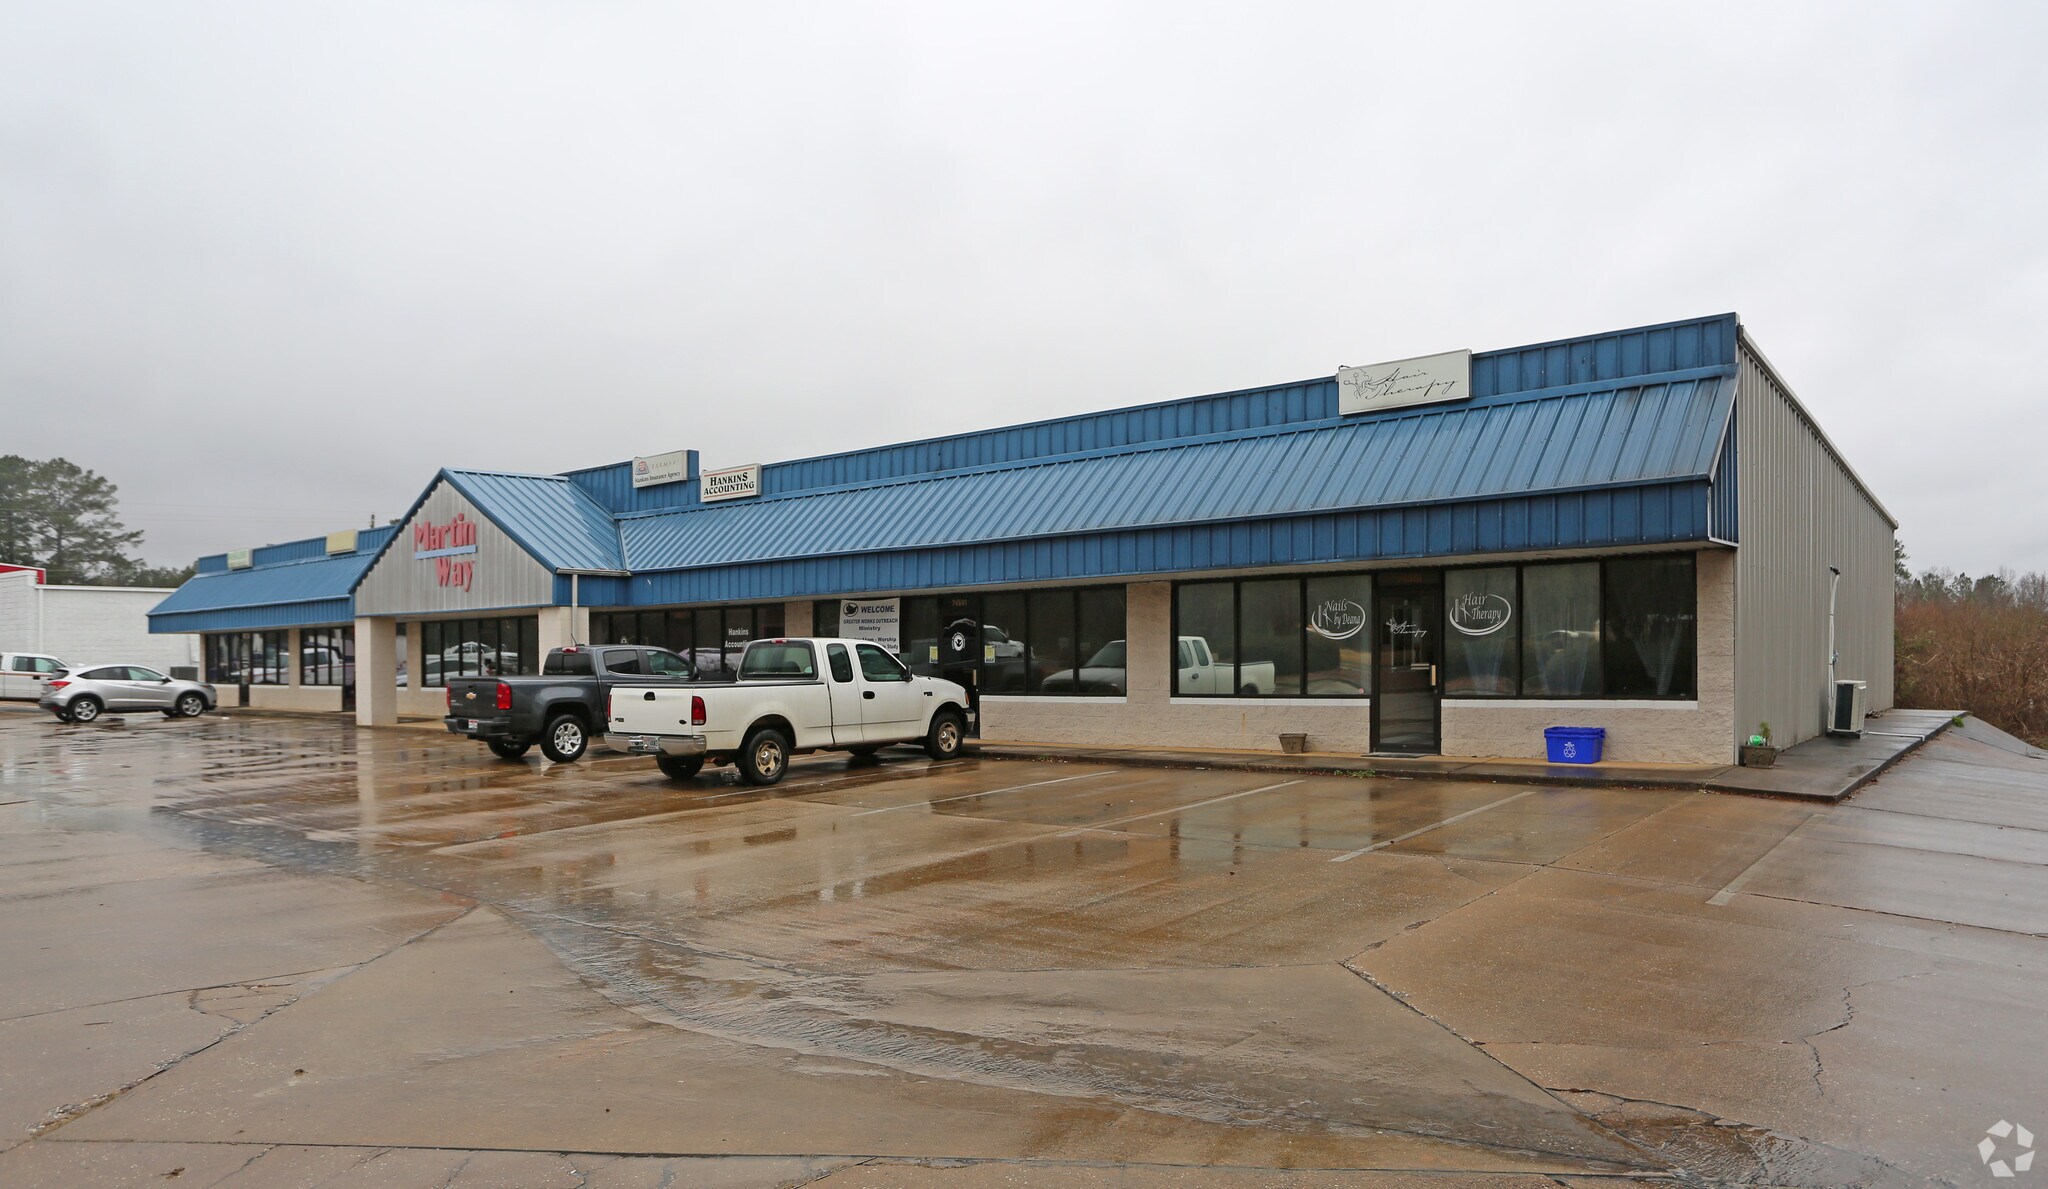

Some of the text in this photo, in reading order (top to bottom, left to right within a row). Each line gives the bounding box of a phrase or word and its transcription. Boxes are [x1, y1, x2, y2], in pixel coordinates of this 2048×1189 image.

[1365, 379, 1460, 400] Therapy
[667, 471, 681, 479] Agency
[710, 472, 748, 486] HANKINS
[703, 481, 755, 495] ACCOUNTING
[414, 512, 476, 552] Martin
[435, 556, 472, 592] Way
[1325, 599, 1348, 611] Nails
[1463, 592, 1488, 605] Hair
[861, 605, 895, 613] WELCOME
[1472, 606, 1502, 623] Therapy
[1333, 612, 1341, 629] by
[728, 628, 749, 636] Hankins
